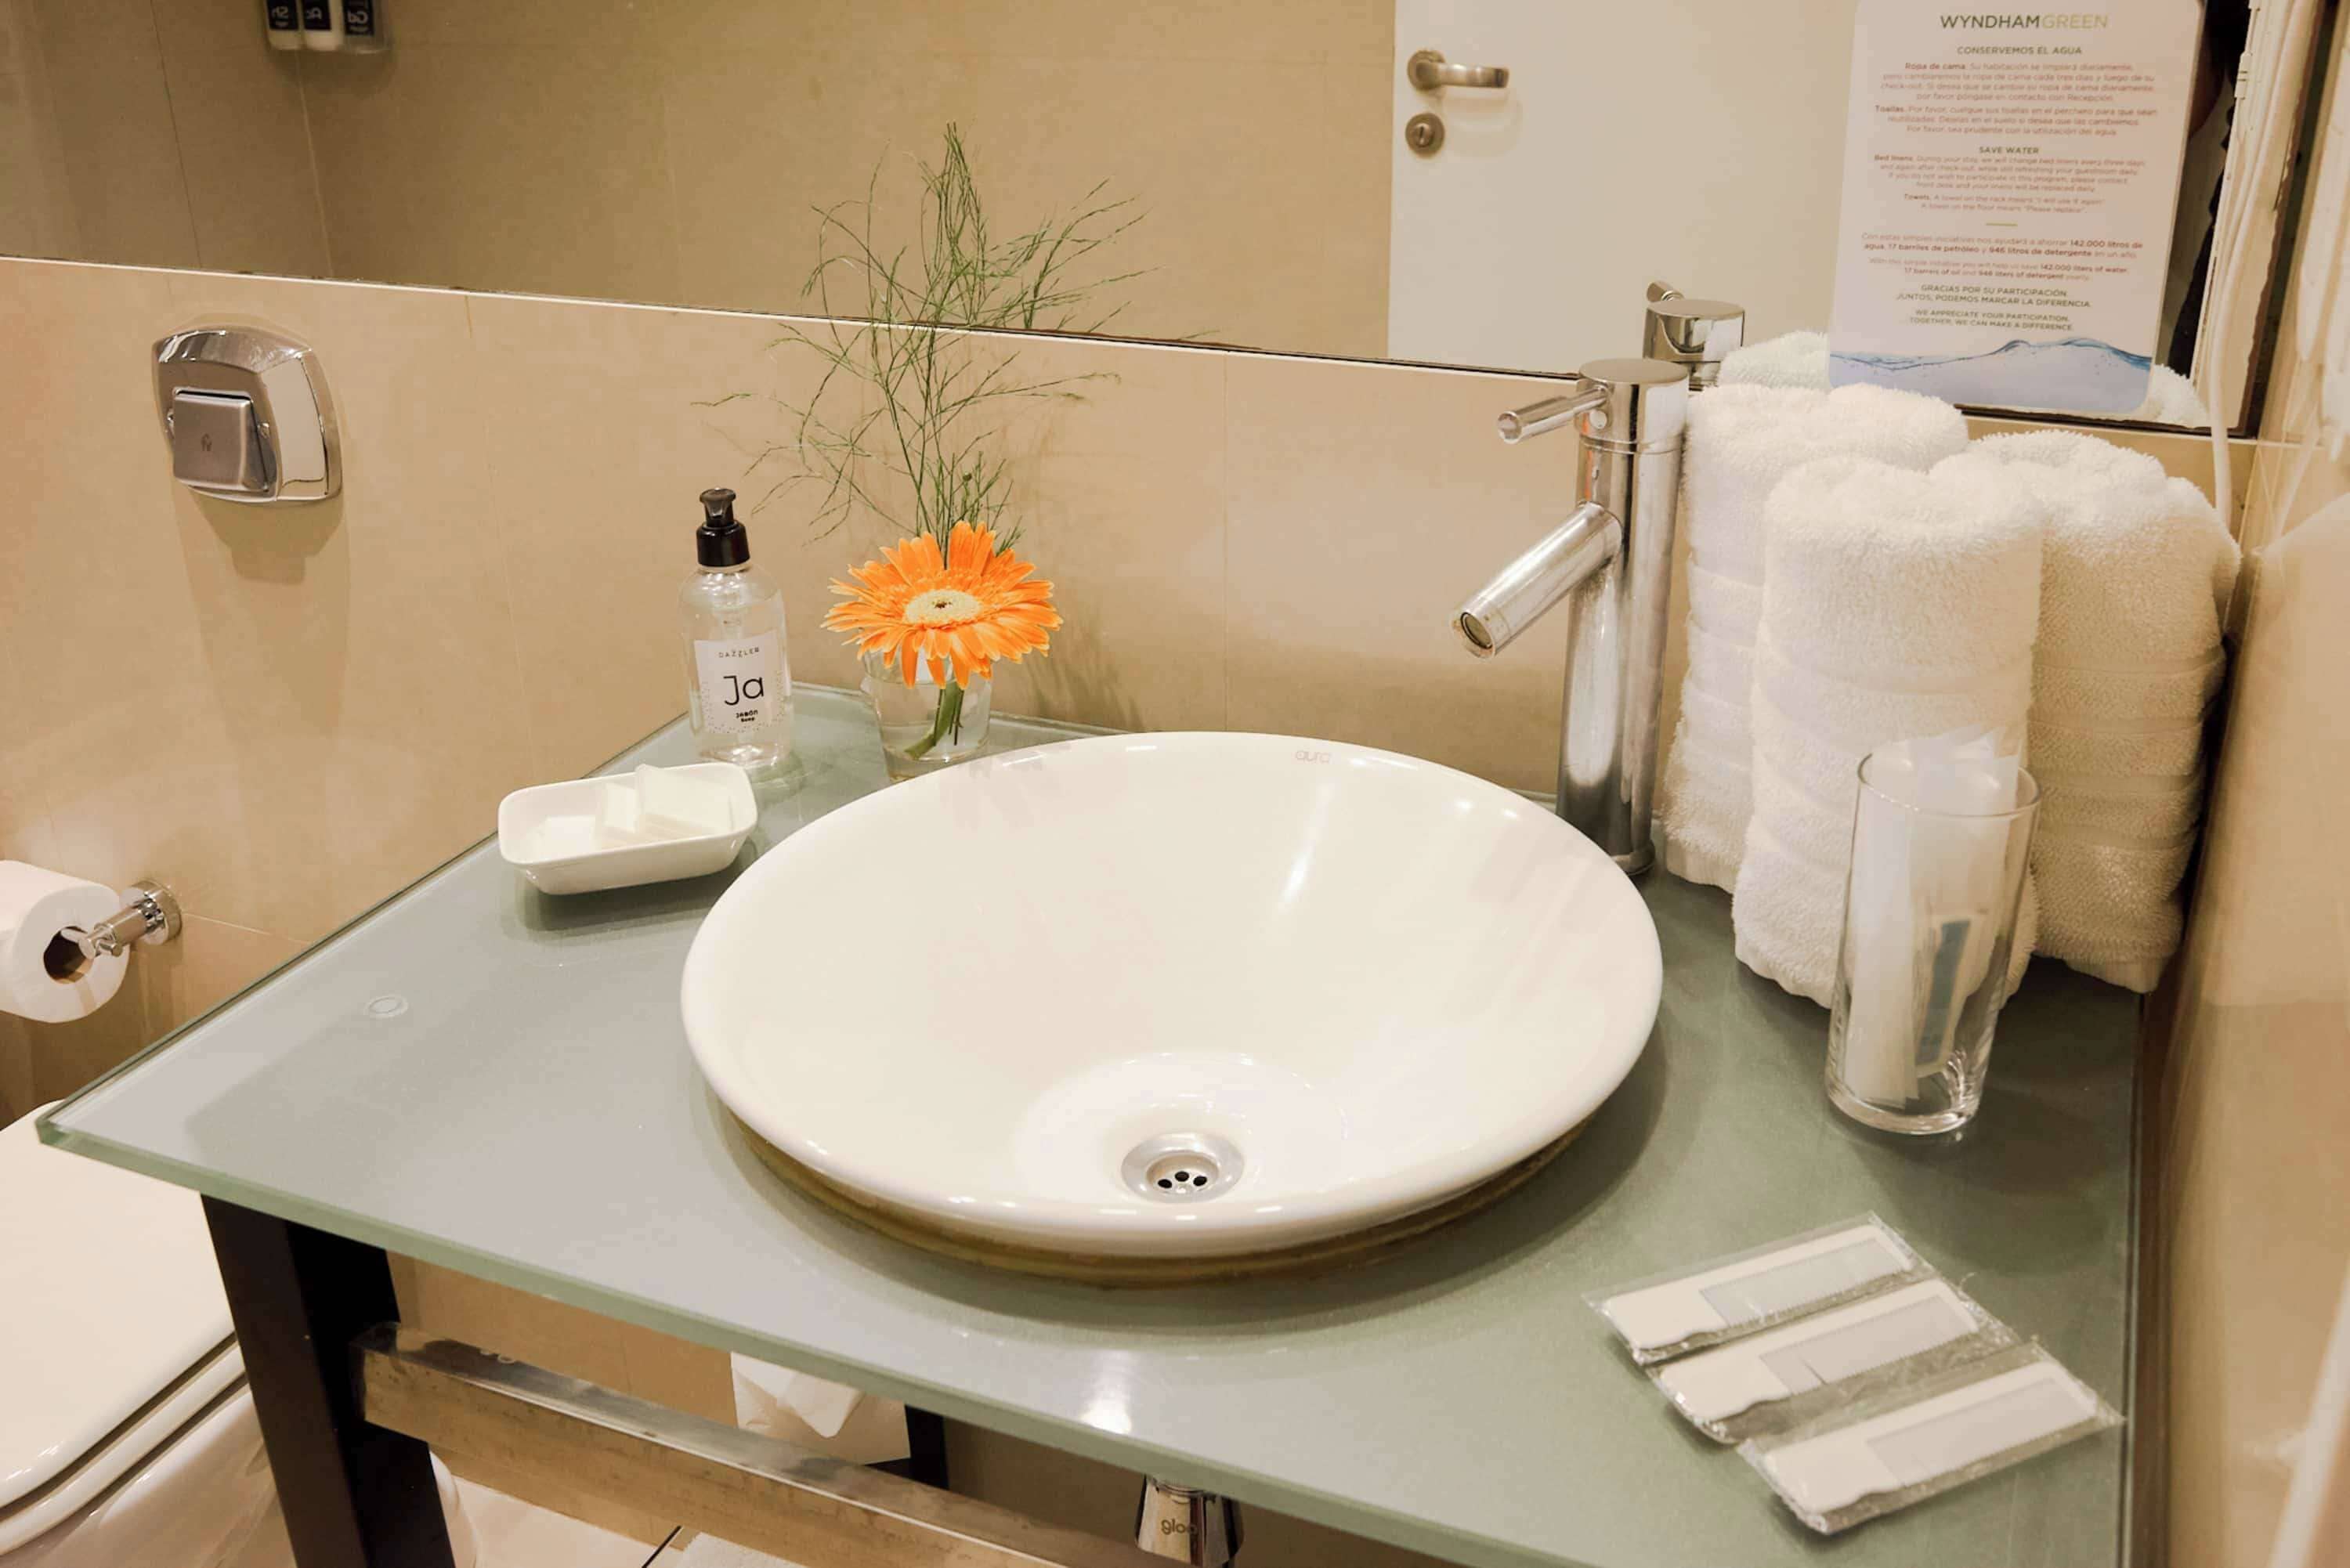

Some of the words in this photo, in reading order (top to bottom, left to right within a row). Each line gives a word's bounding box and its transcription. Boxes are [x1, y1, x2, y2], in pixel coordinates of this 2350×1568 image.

[1957, 46, 2034, 55] CONSERVEMOS
[2037, 46, 2048, 55] EL
[2052, 46, 2082, 55] AGUA
[1943, 245, 1979, 255] petróleo
[2044, 248, 2092, 258] detergente
[2026, 271, 2063, 280] detergent
[1921, 284, 1960, 293] GRACIAS
[723, 675, 764, 706] Ja
